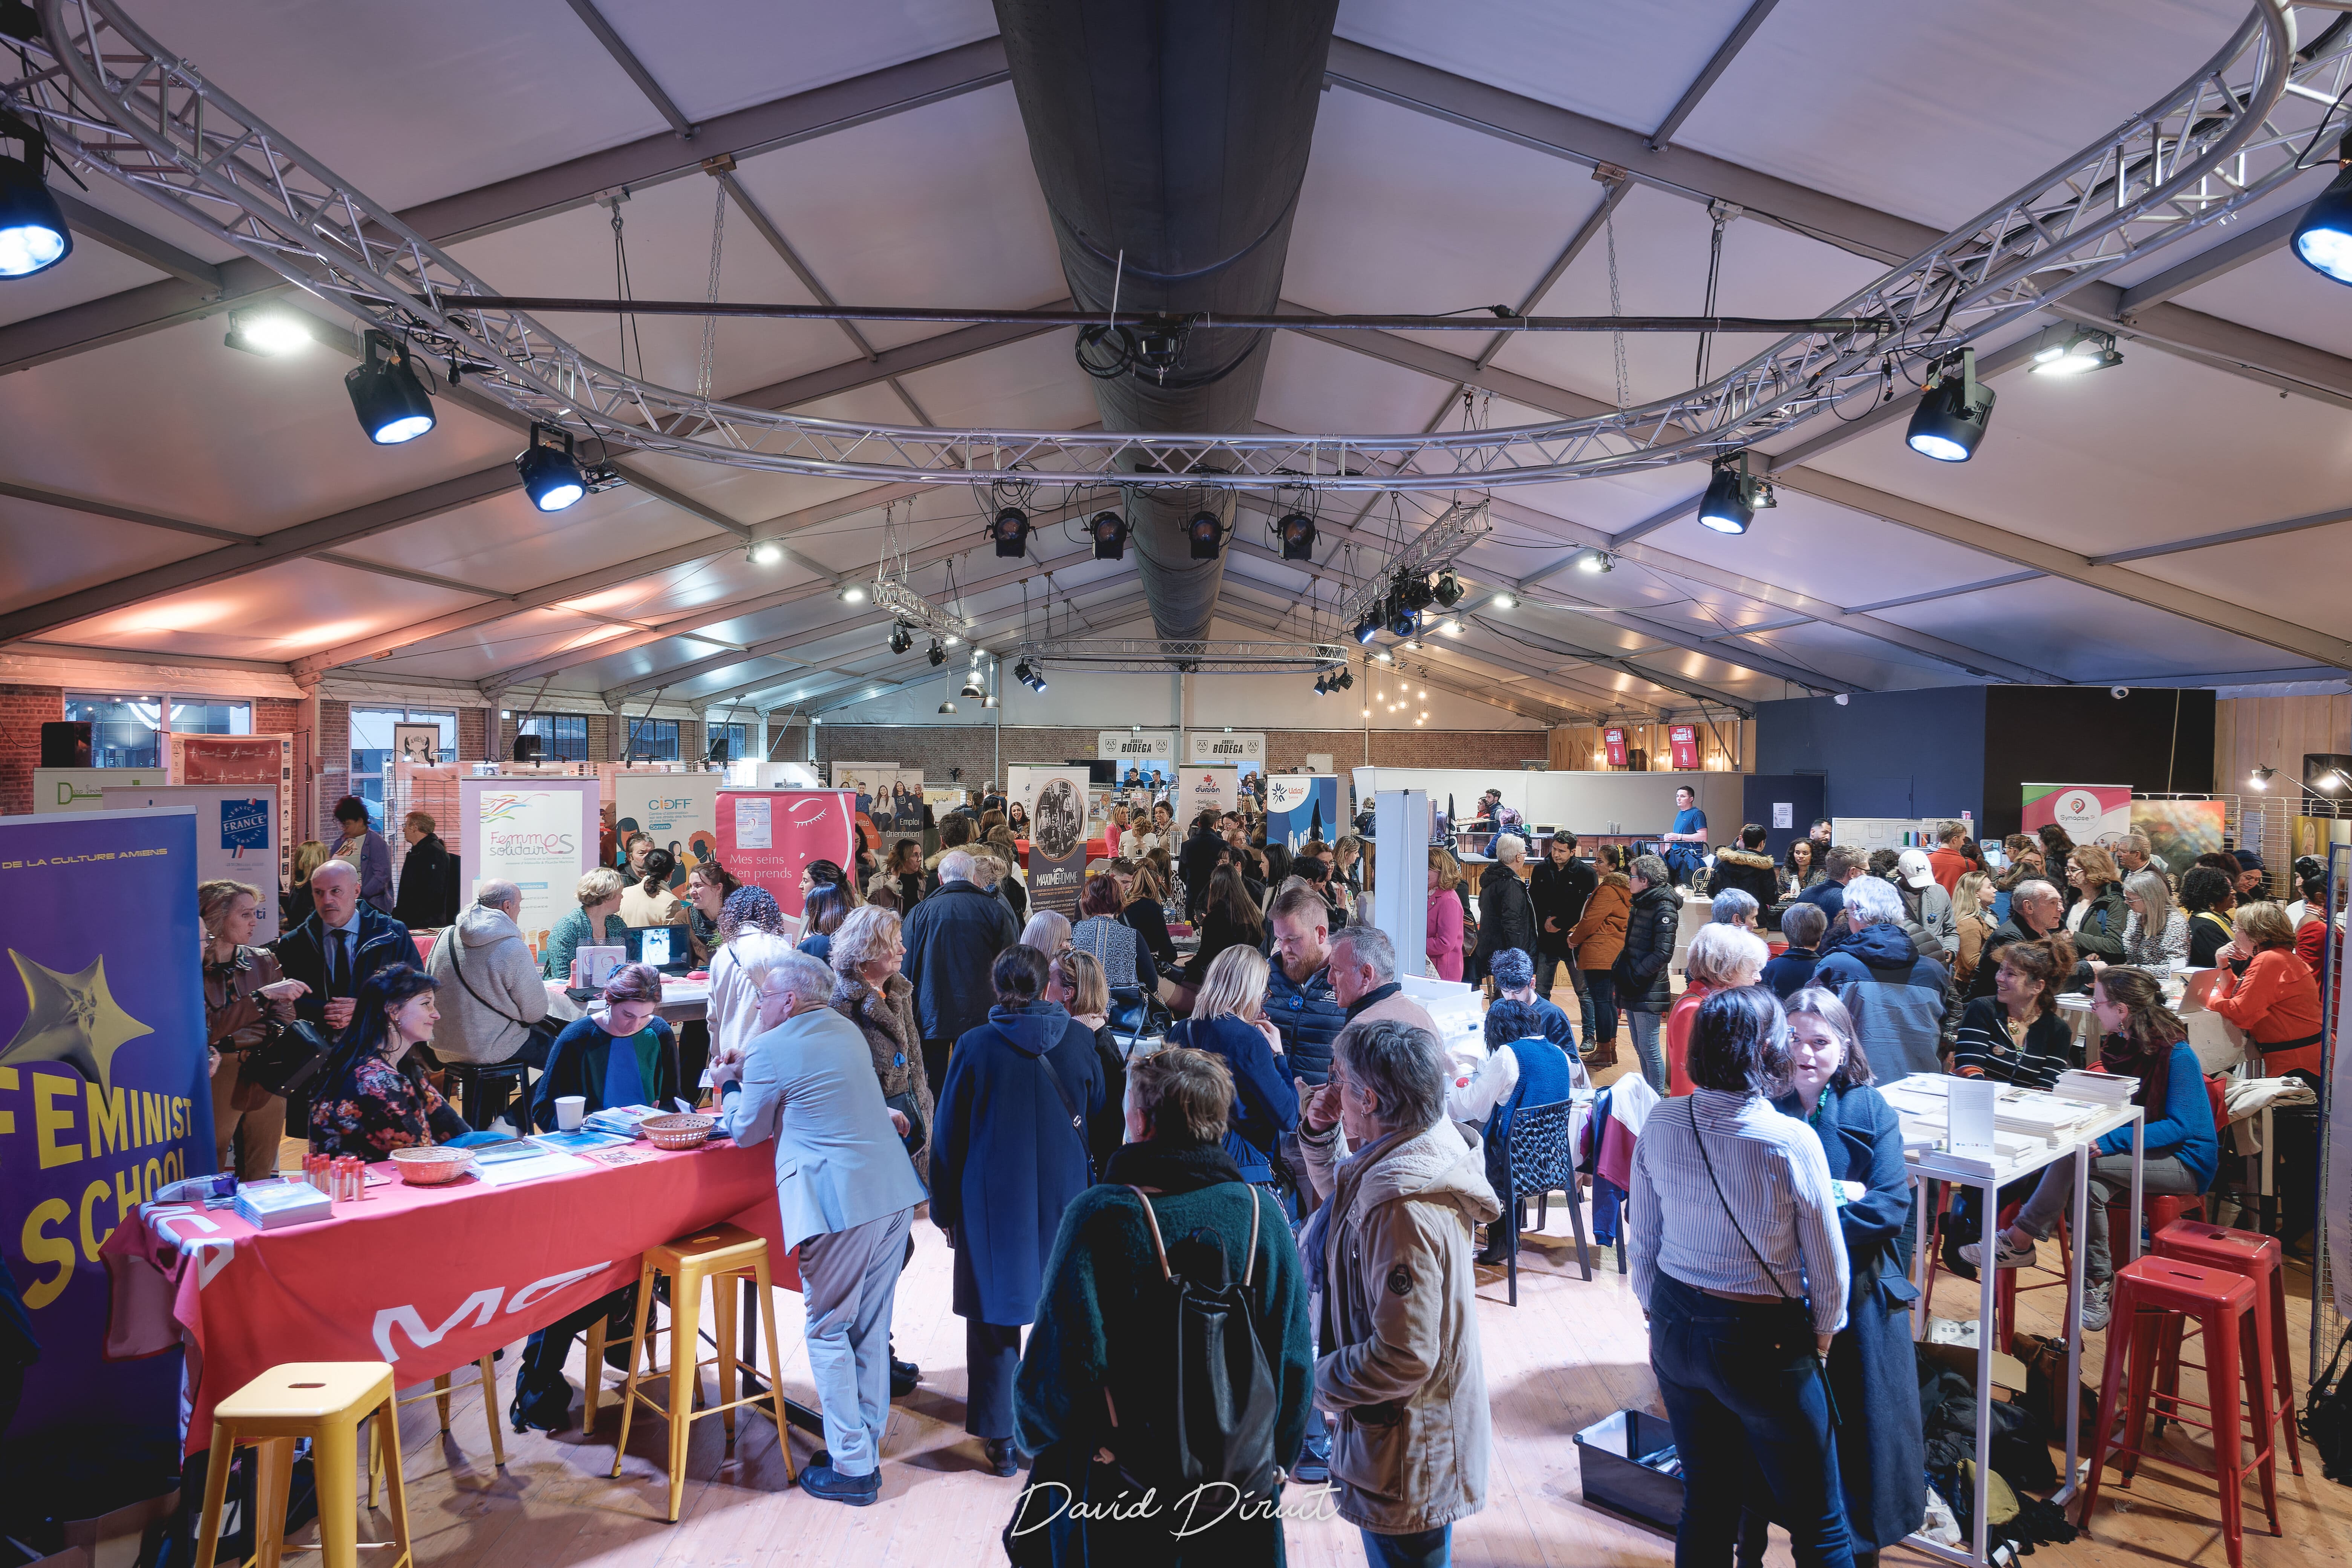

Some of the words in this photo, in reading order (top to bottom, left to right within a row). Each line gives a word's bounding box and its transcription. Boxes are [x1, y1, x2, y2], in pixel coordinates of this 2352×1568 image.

[1121, 743, 1152, 753] BODEGA
[1213, 744, 1243, 753] BODEGA
[223, 815, 265, 831] FRANCE
[900, 818, 919, 827] Emploi
[491, 831, 574, 854] Femmes
[2, 861, 23, 869] DE
[51, 853, 115, 864] CULTURE
[119, 848, 168, 859] AMIENS
[730, 854, 752, 864] Mes
[756, 854, 784, 864] seins
[755, 867, 792, 881] prends
